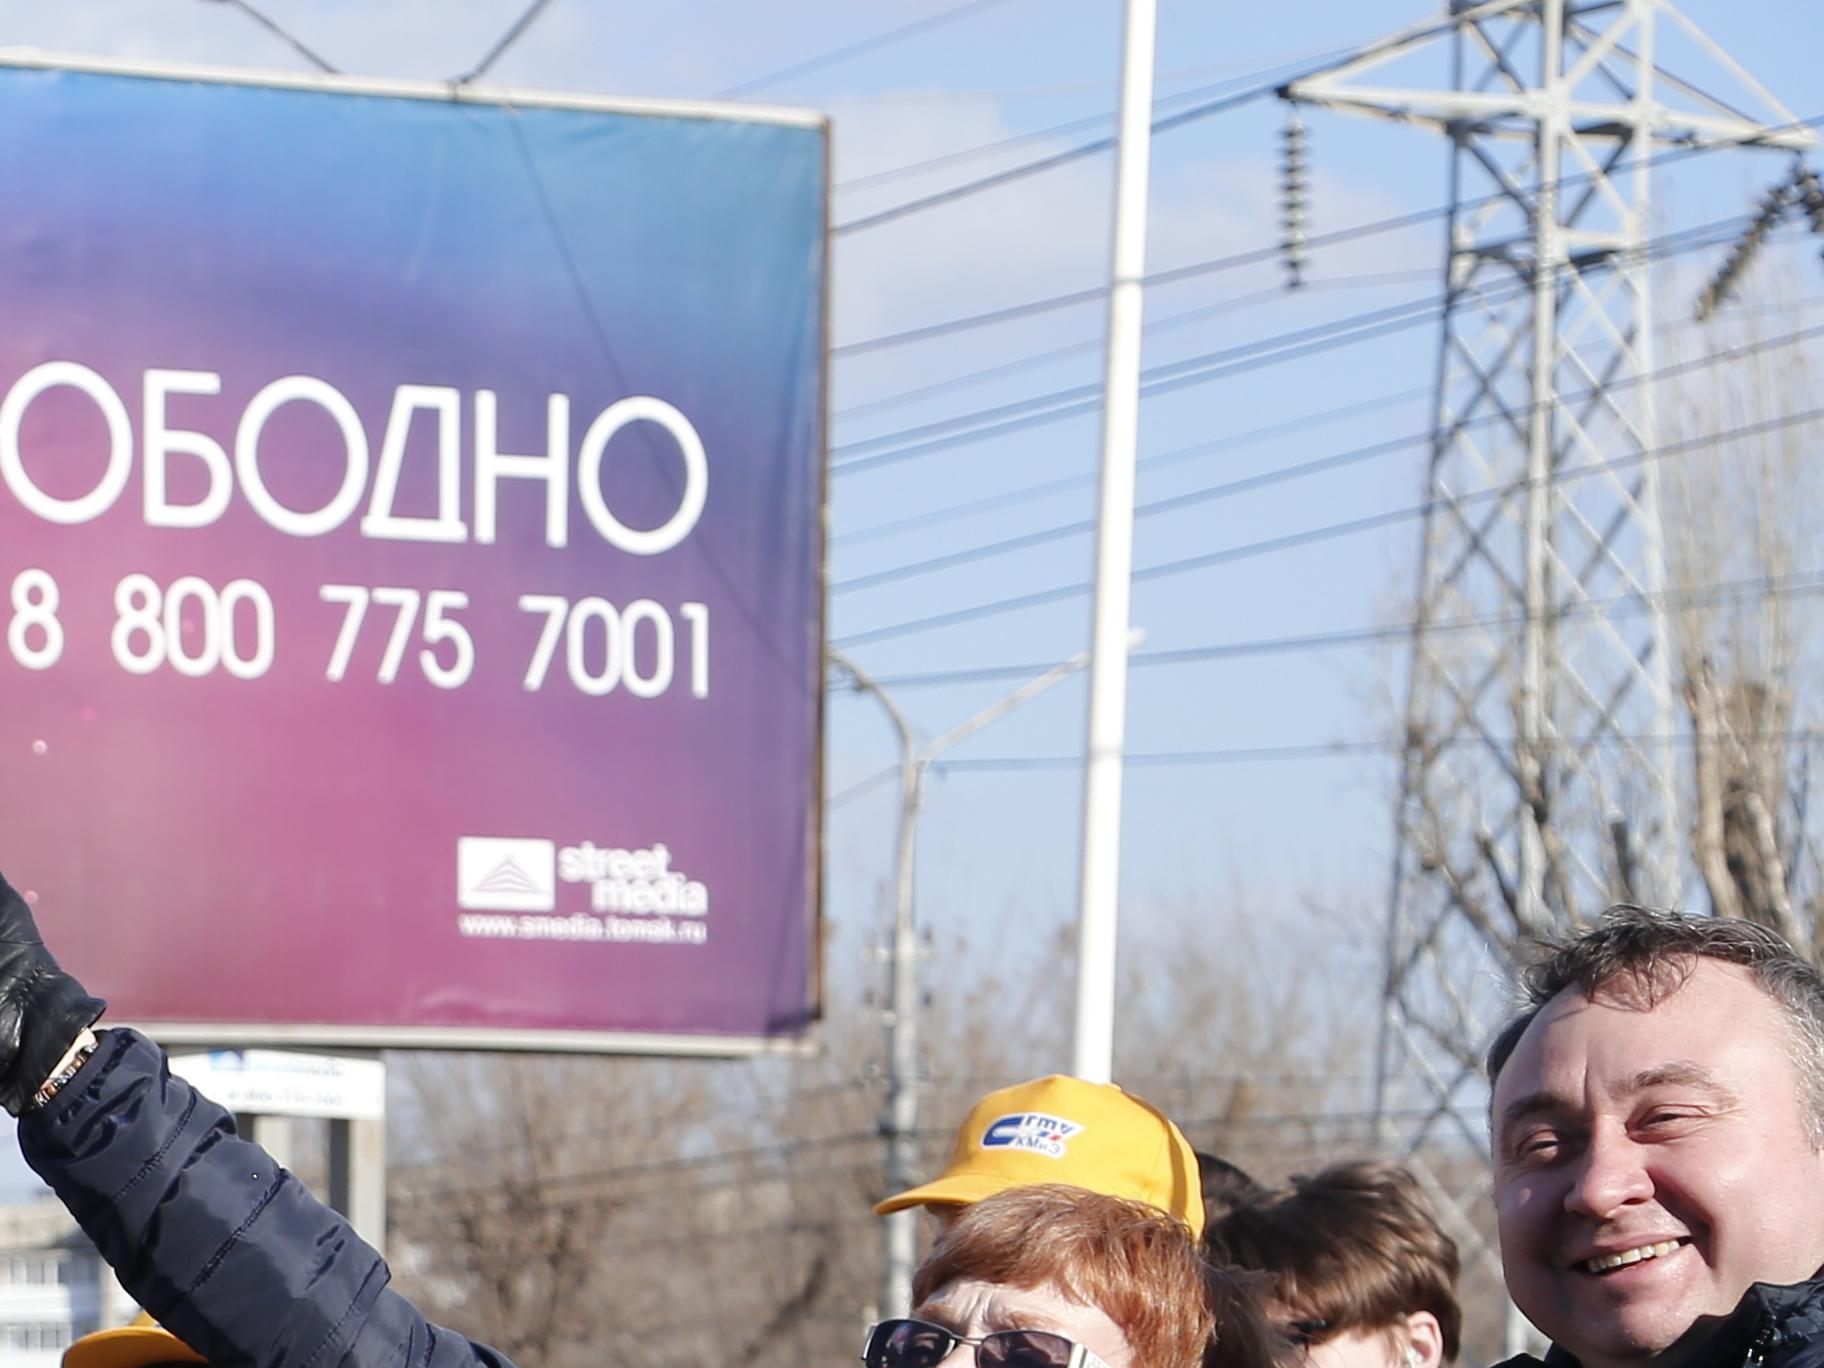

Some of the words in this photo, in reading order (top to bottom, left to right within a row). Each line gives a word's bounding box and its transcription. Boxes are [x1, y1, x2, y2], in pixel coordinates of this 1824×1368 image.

[7, 568, 65, 670] 8
[110, 573, 275, 680] 800
[319, 584, 475, 689] 775
[518, 594, 709, 698] 7001
[558, 841, 670, 882] street
[592, 872, 708, 916] media
